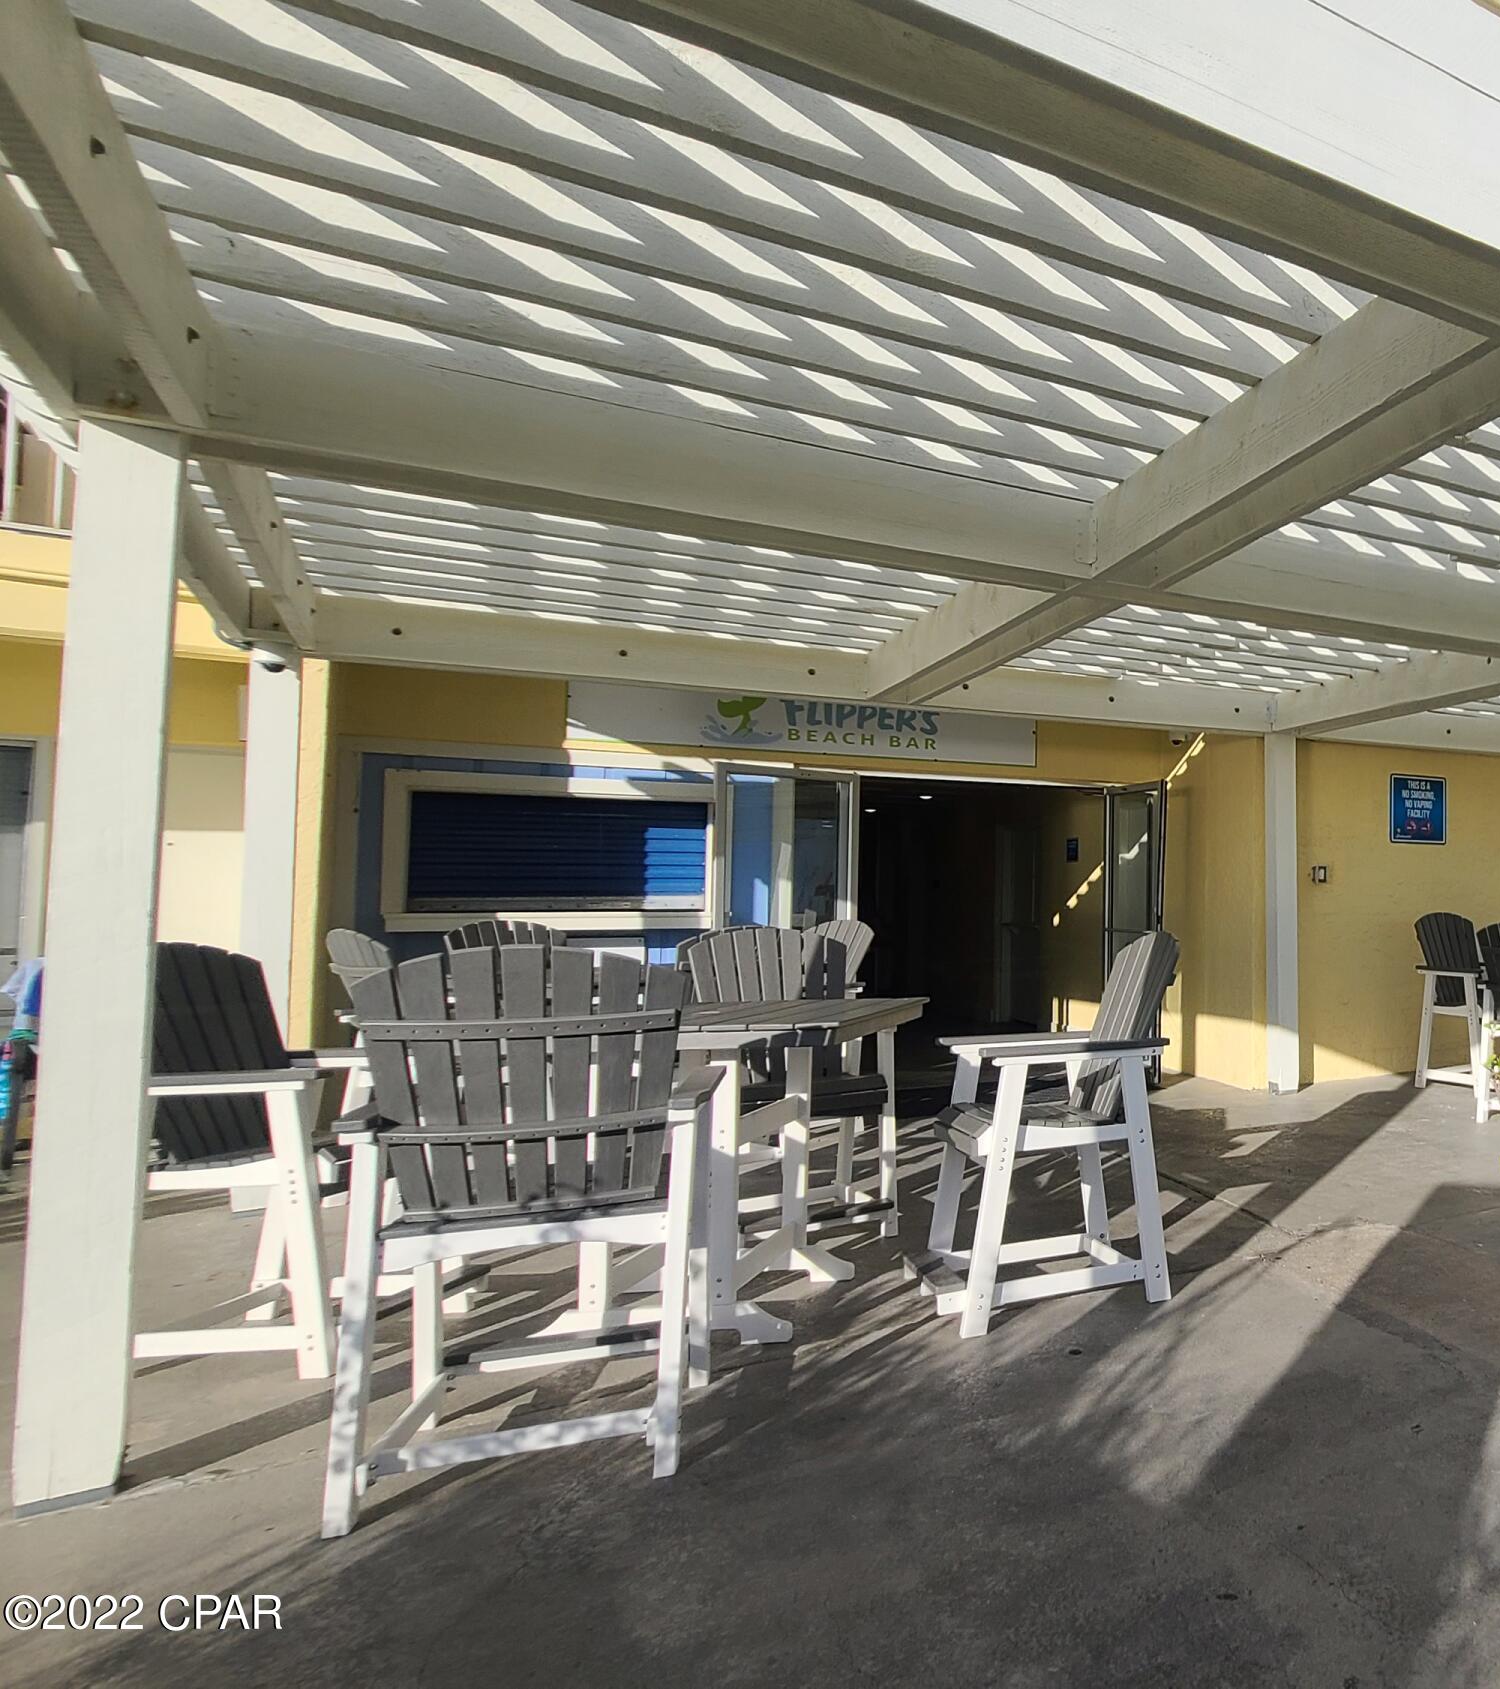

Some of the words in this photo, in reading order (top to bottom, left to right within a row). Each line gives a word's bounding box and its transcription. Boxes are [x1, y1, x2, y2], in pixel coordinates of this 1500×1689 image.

[787, 728, 874, 746] BEACH
[889, 735, 936, 750] BAR
[1408, 780, 1419, 789] THIS
[1420, 781, 1425, 790] IS
[1402, 789, 1409, 798] NO
[1405, 799, 1412, 808] NO
[1413, 800, 1432, 809] VAPING
[1407, 809, 1430, 818] FACILITY
